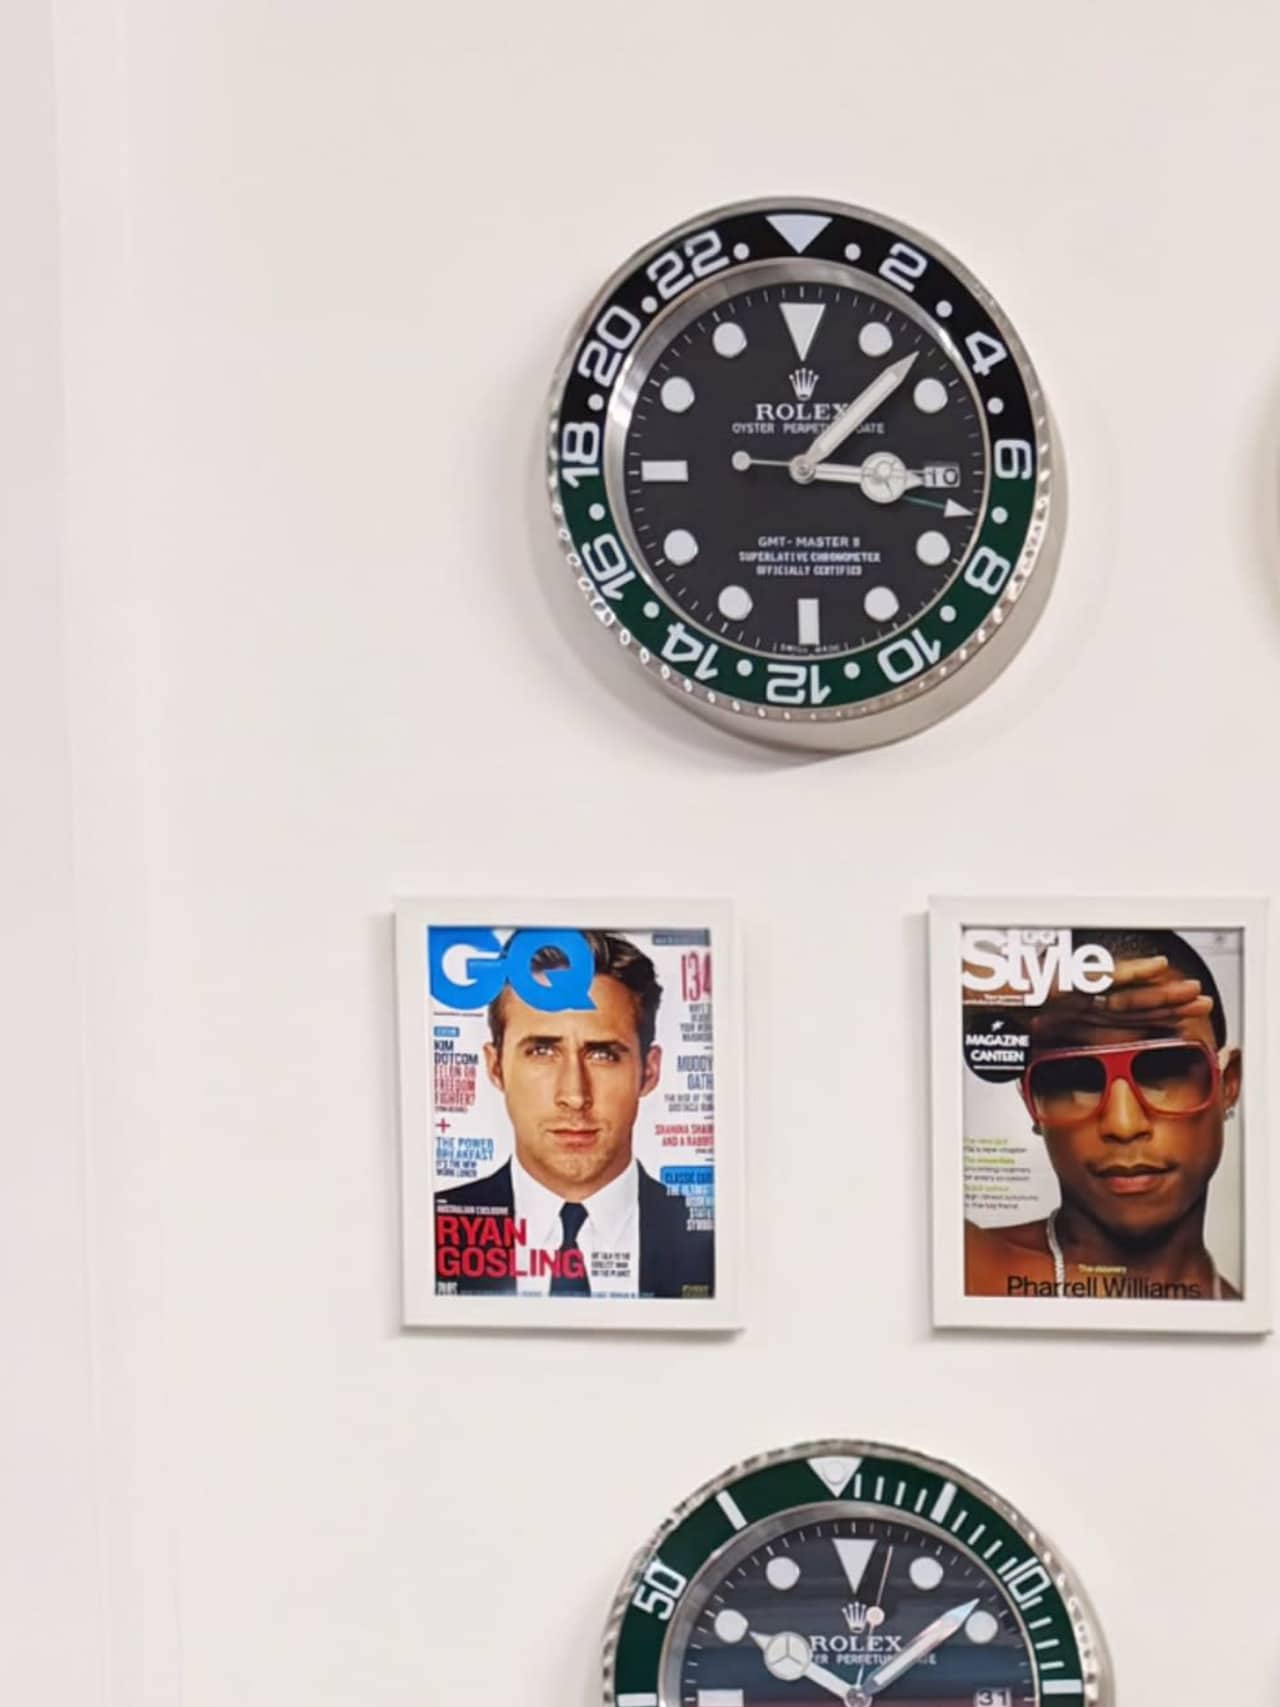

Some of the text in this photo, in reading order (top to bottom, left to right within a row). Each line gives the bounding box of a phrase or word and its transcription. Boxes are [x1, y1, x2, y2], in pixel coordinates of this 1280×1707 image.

[649, 231, 730, 299] 22
[579, 306, 641, 385] 20
[964, 331, 1008, 376] 4
[756, 402, 849, 422] ROLEX
[562, 423, 600, 488] 18
[428, 926, 597, 1013] GQ
[682, 953, 712, 1003] 134
[962, 930, 1114, 1006] Style
[434, 1040, 454, 1050] KIM
[966, 1034, 1029, 1048] MAGAZINE
[971, 1050, 1025, 1062] CANTEEN
[434, 1053, 479, 1065] DOTCOM
[437, 1216, 526, 1247] RYAN
[437, 1248, 584, 1278] GOSLING
[1007, 1276, 1200, 1299] Pharrell Williams
[633, 1559, 686, 1620] 50
[809, 1636, 901, 1652] ROLEX
